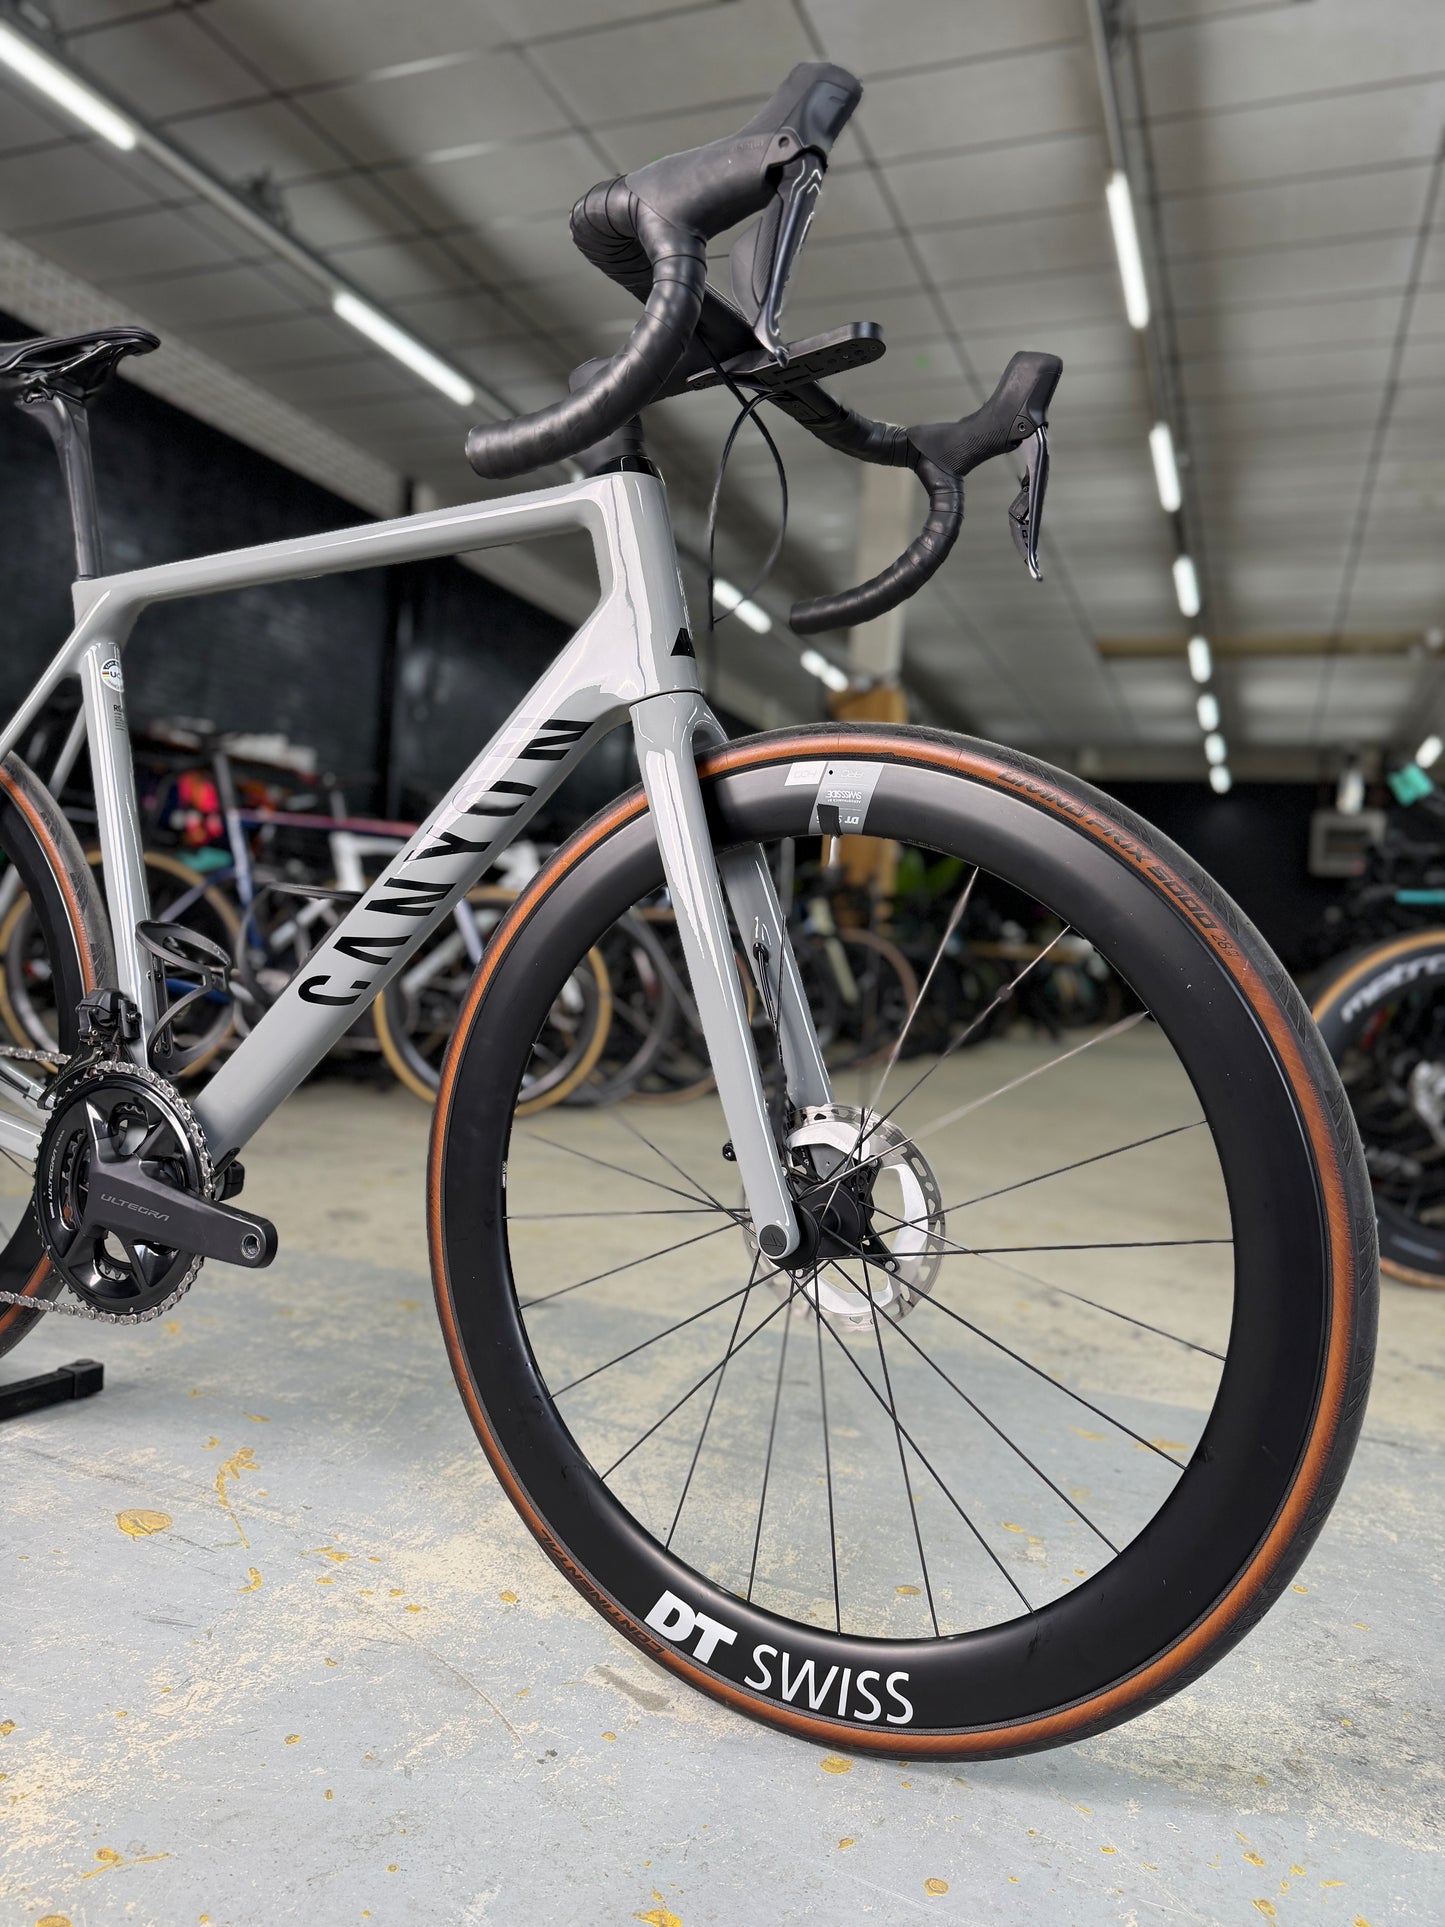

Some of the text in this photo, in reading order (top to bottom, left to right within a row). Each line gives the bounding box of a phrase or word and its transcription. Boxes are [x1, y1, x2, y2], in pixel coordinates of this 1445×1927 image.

[298, 719, 595, 1006] CANYON
[844, 816, 860, 825] DT
[997, 771, 1089, 818] GRAND
[1086, 818, 1152, 863] PRIX
[1147, 865, 1218, 929] 5000
[47, 1148, 57, 1200] ULTEGRA
[100, 1193, 170, 1222] ULTEGRA
[644, 1589, 914, 1725] DT SWISS
